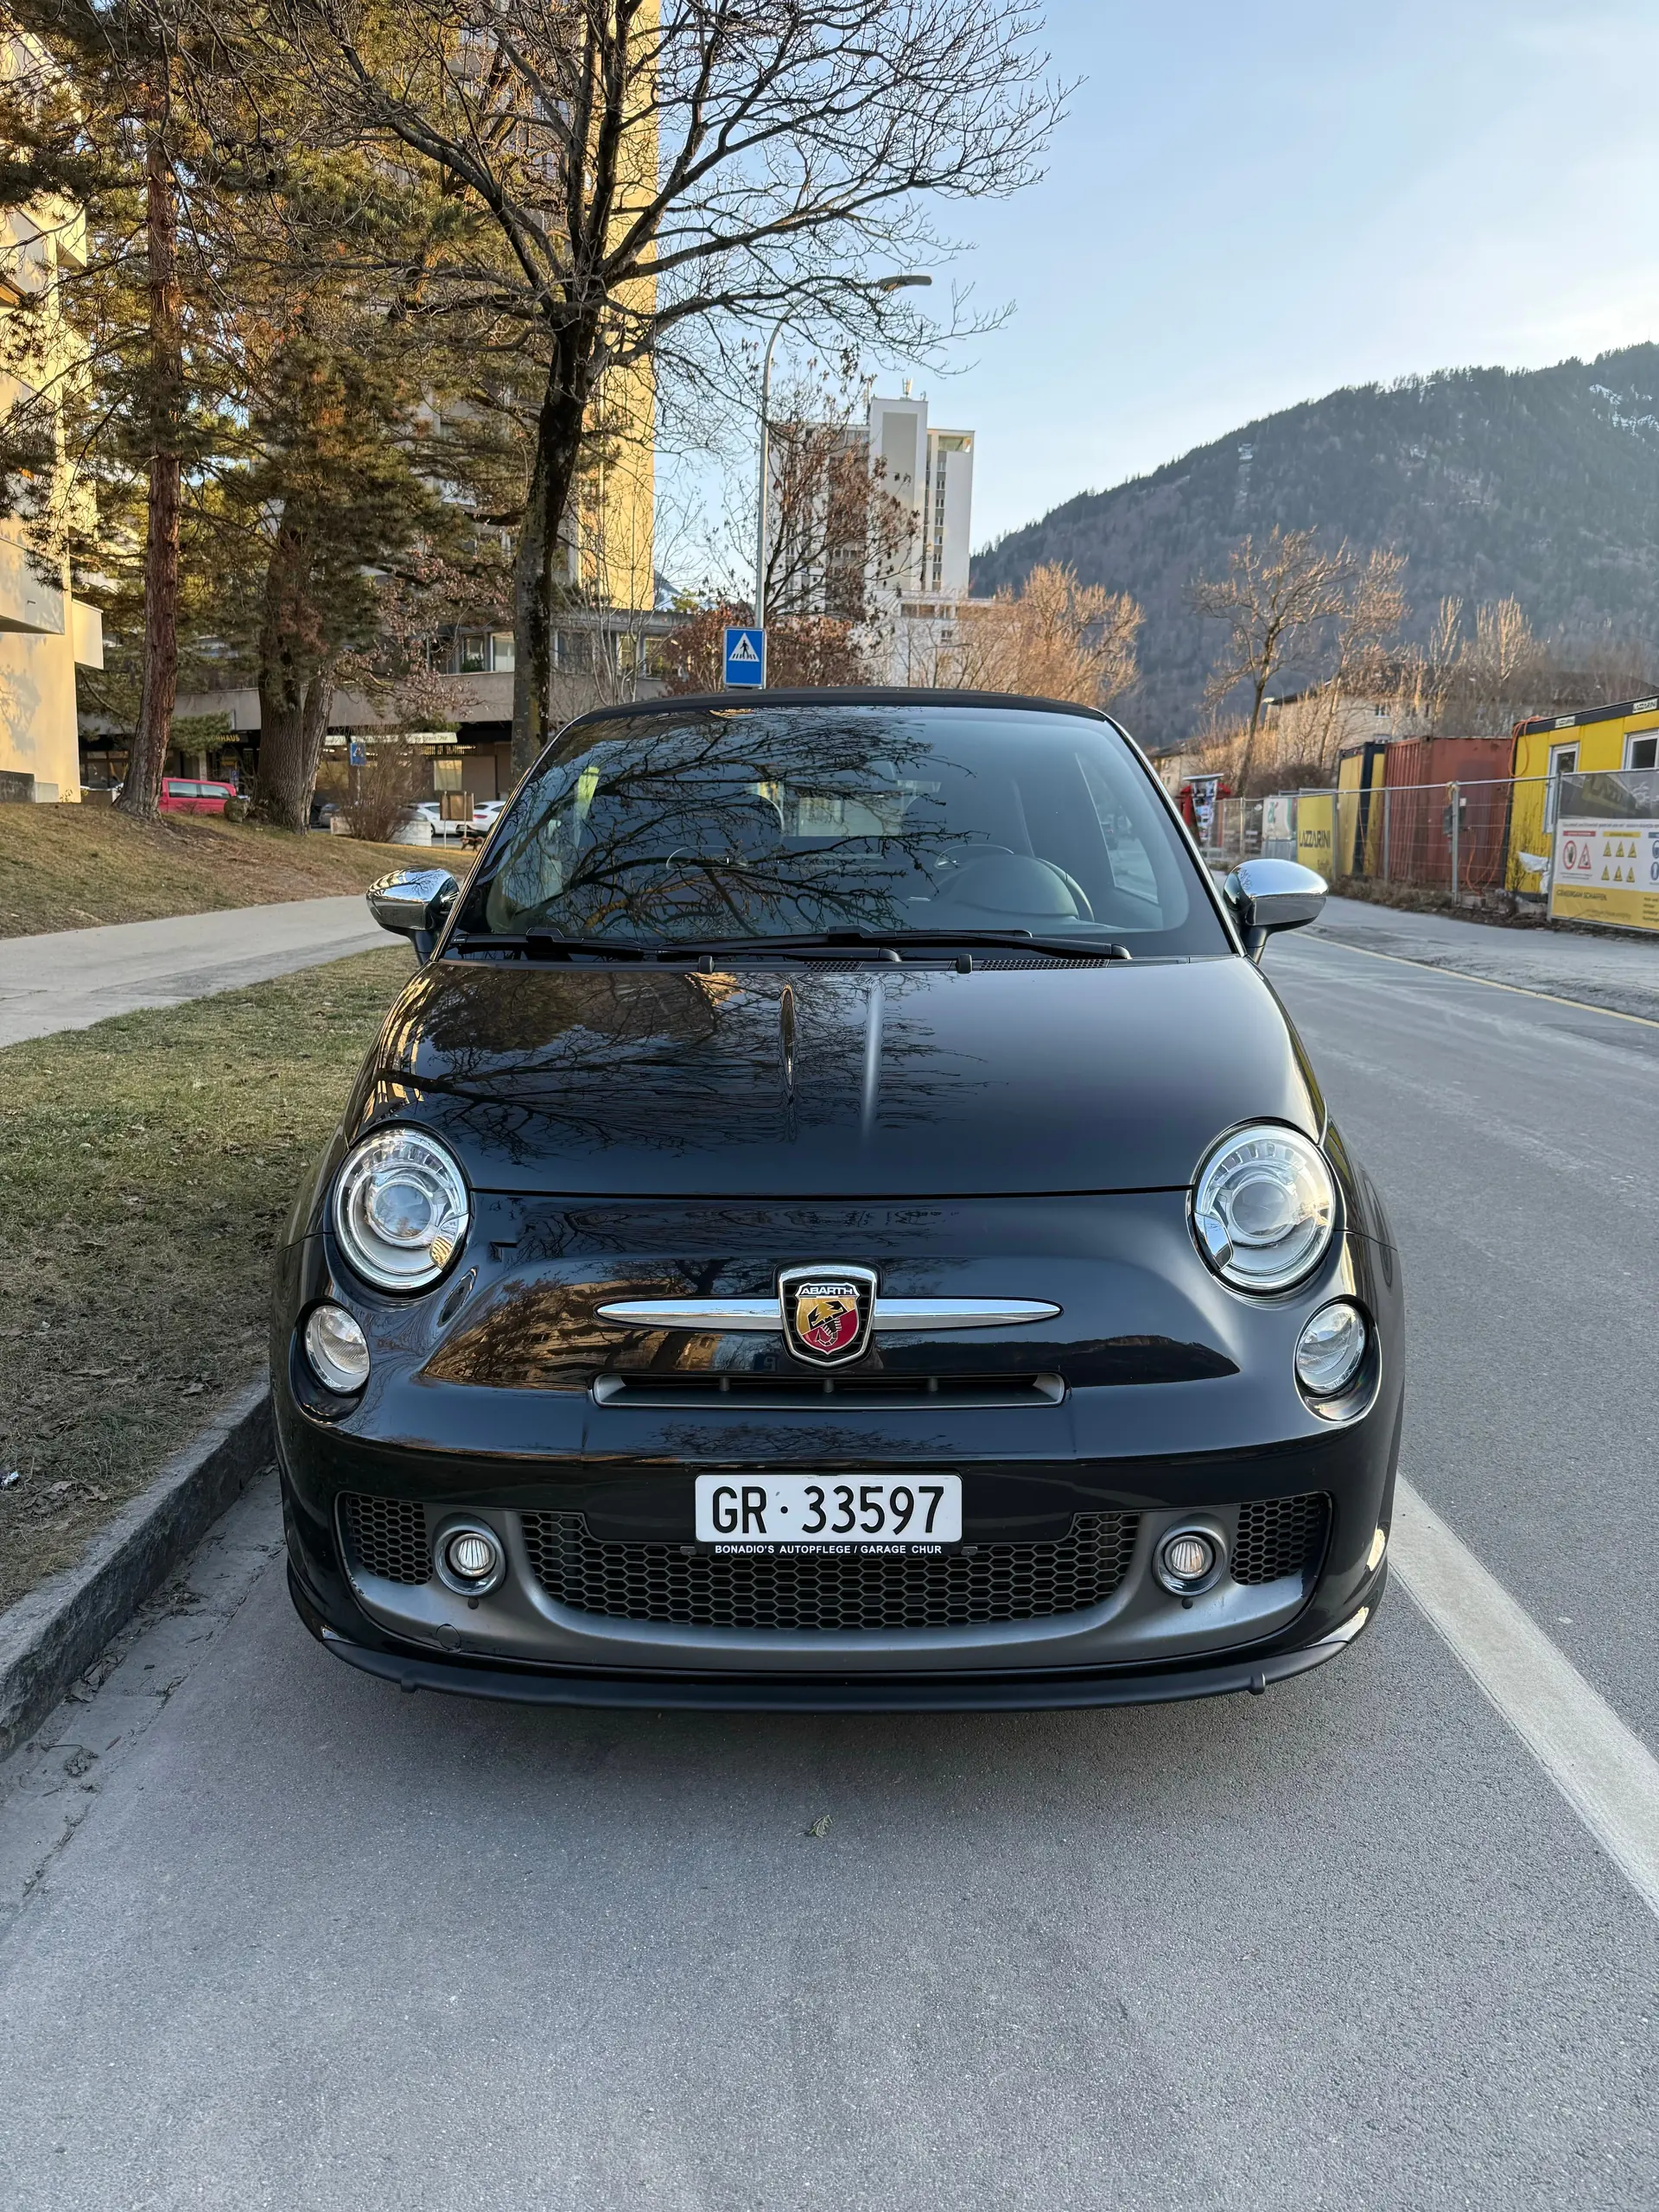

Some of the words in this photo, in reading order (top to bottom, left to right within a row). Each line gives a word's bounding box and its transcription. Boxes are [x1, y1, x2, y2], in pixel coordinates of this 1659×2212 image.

[1299, 830, 1331, 849] LAZZARINI
[801, 1287, 853, 1295] ABARTH
[712, 1485, 767, 1534] GR
[801, 1484, 944, 1535] 33597
[715, 1544, 775, 1554] BONADIO'S
[779, 1544, 851, 1554] AUTOPFLEGE
[860, 1544, 906, 1554] GARAGE
[911, 1544, 942, 1554] CHUR
